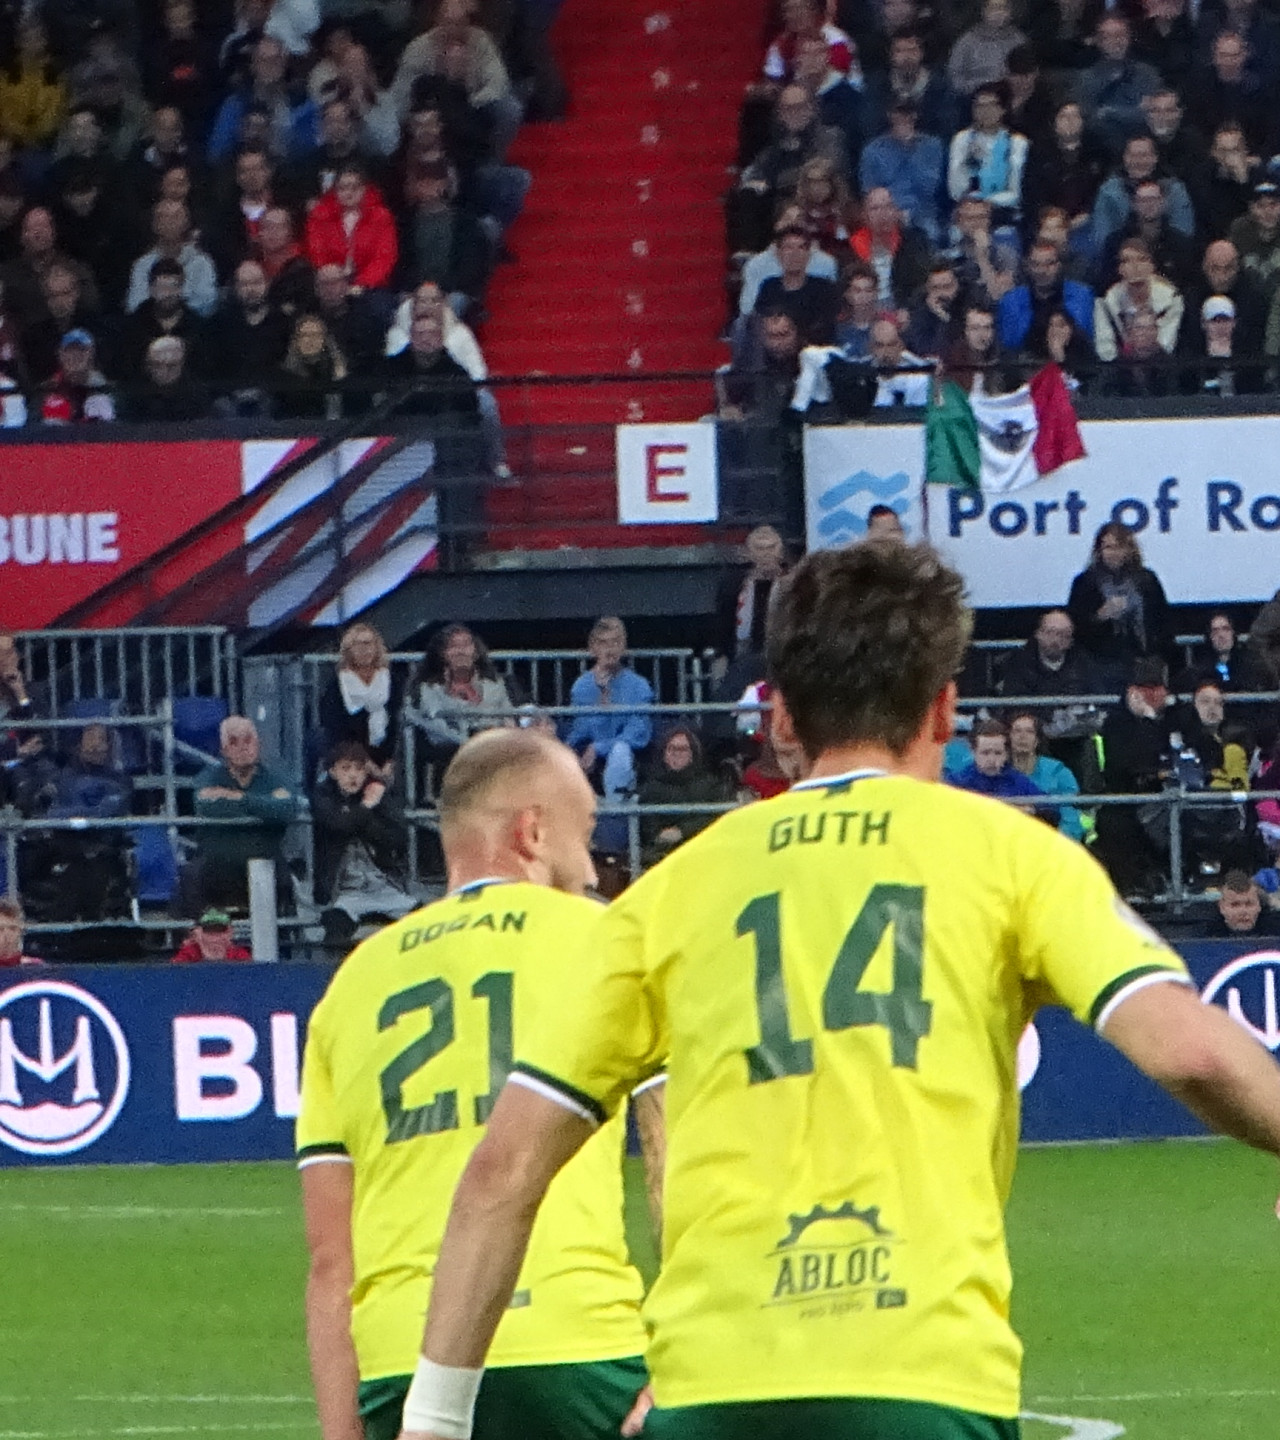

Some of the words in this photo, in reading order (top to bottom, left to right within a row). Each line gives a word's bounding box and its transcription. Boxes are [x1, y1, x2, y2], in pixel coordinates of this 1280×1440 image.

[646, 443, 689, 503] E
[948, 487, 1087, 537] Port
[1111, 476, 1179, 534] of
[768, 811, 892, 852] GUTH
[735, 882, 933, 1085] 14
[376, 971, 517, 1146] 21
[773, 1246, 892, 1298] ABLOC
